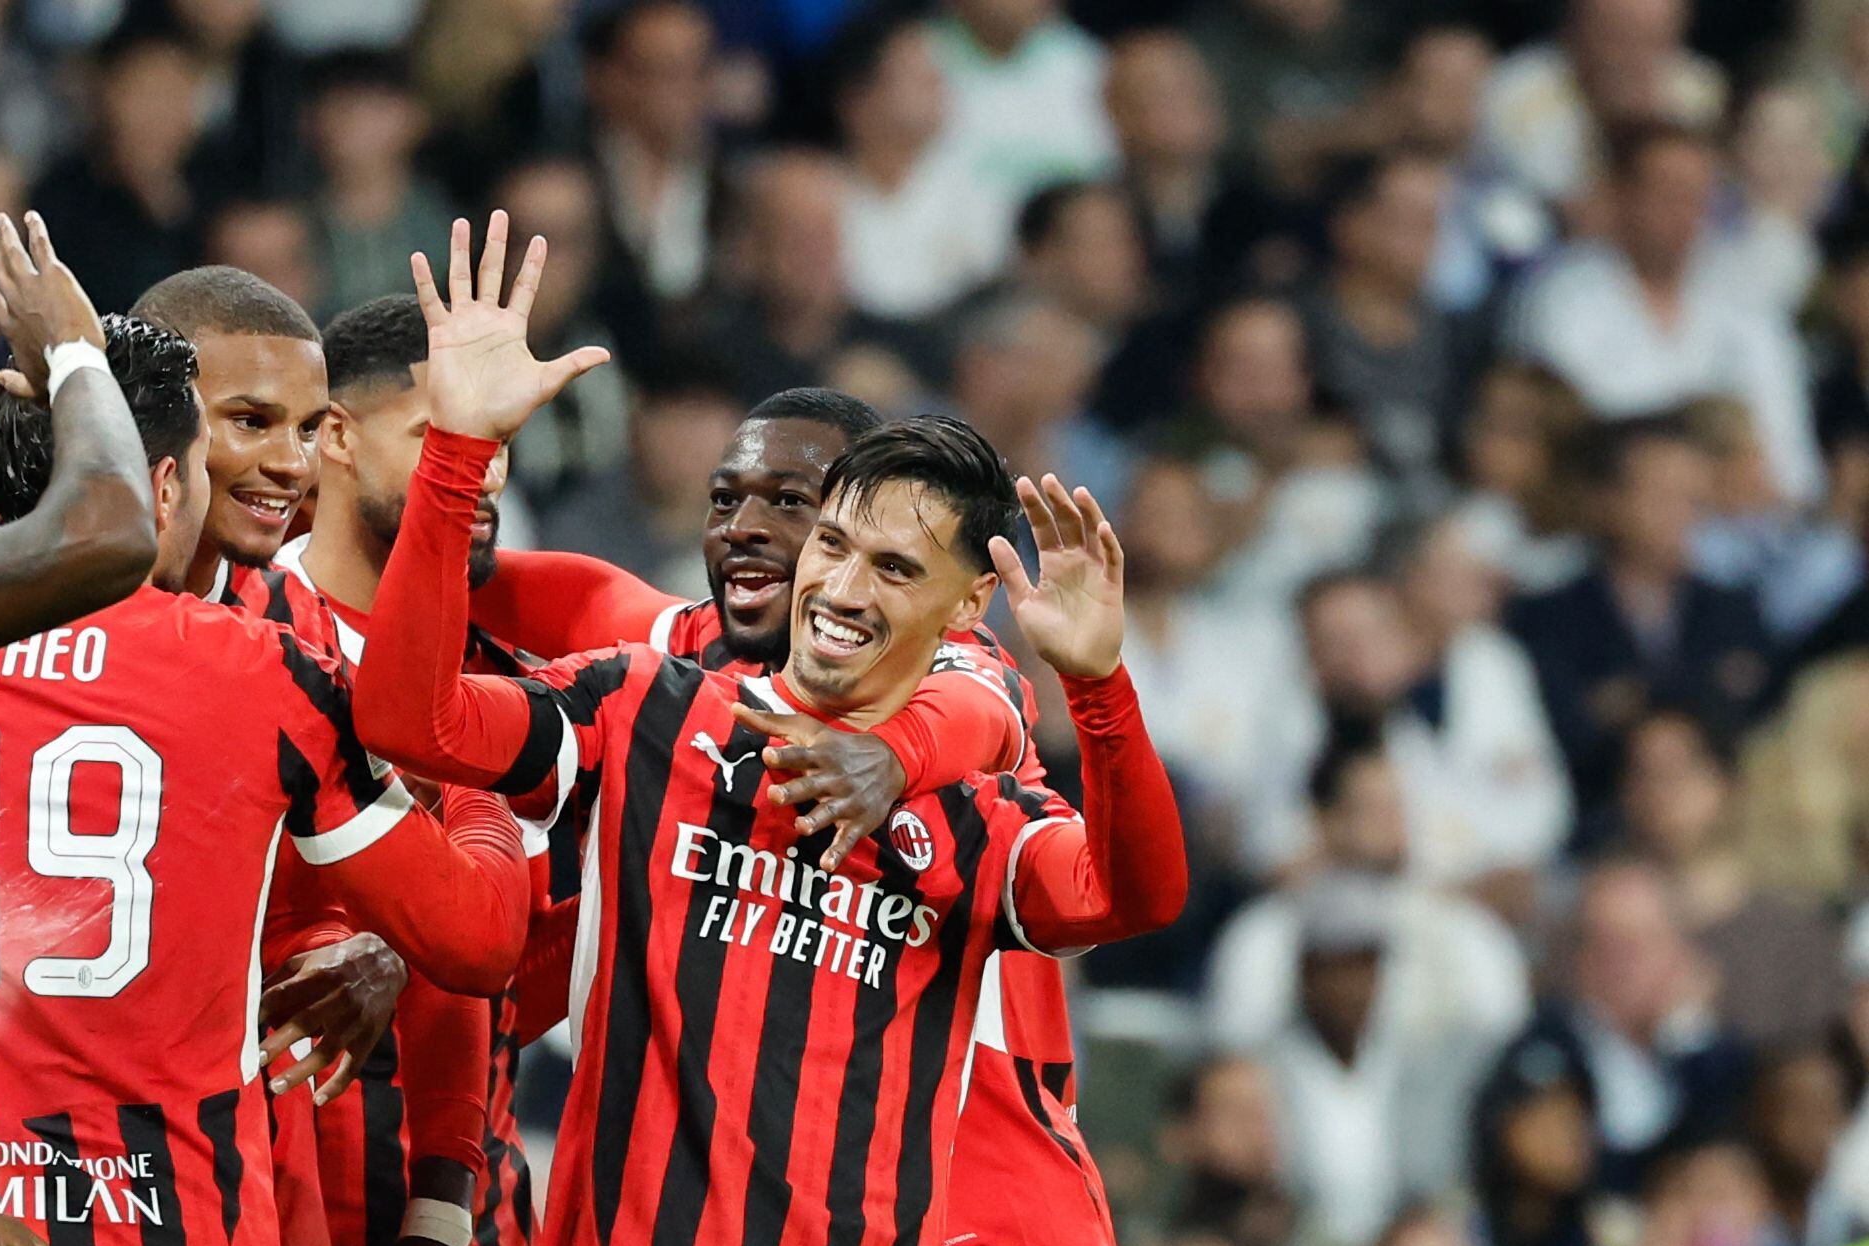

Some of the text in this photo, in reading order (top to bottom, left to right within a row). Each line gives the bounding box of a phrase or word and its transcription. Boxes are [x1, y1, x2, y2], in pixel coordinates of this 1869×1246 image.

[670, 821, 940, 948] Emirates
[699, 895, 888, 990] FLY BETTER
